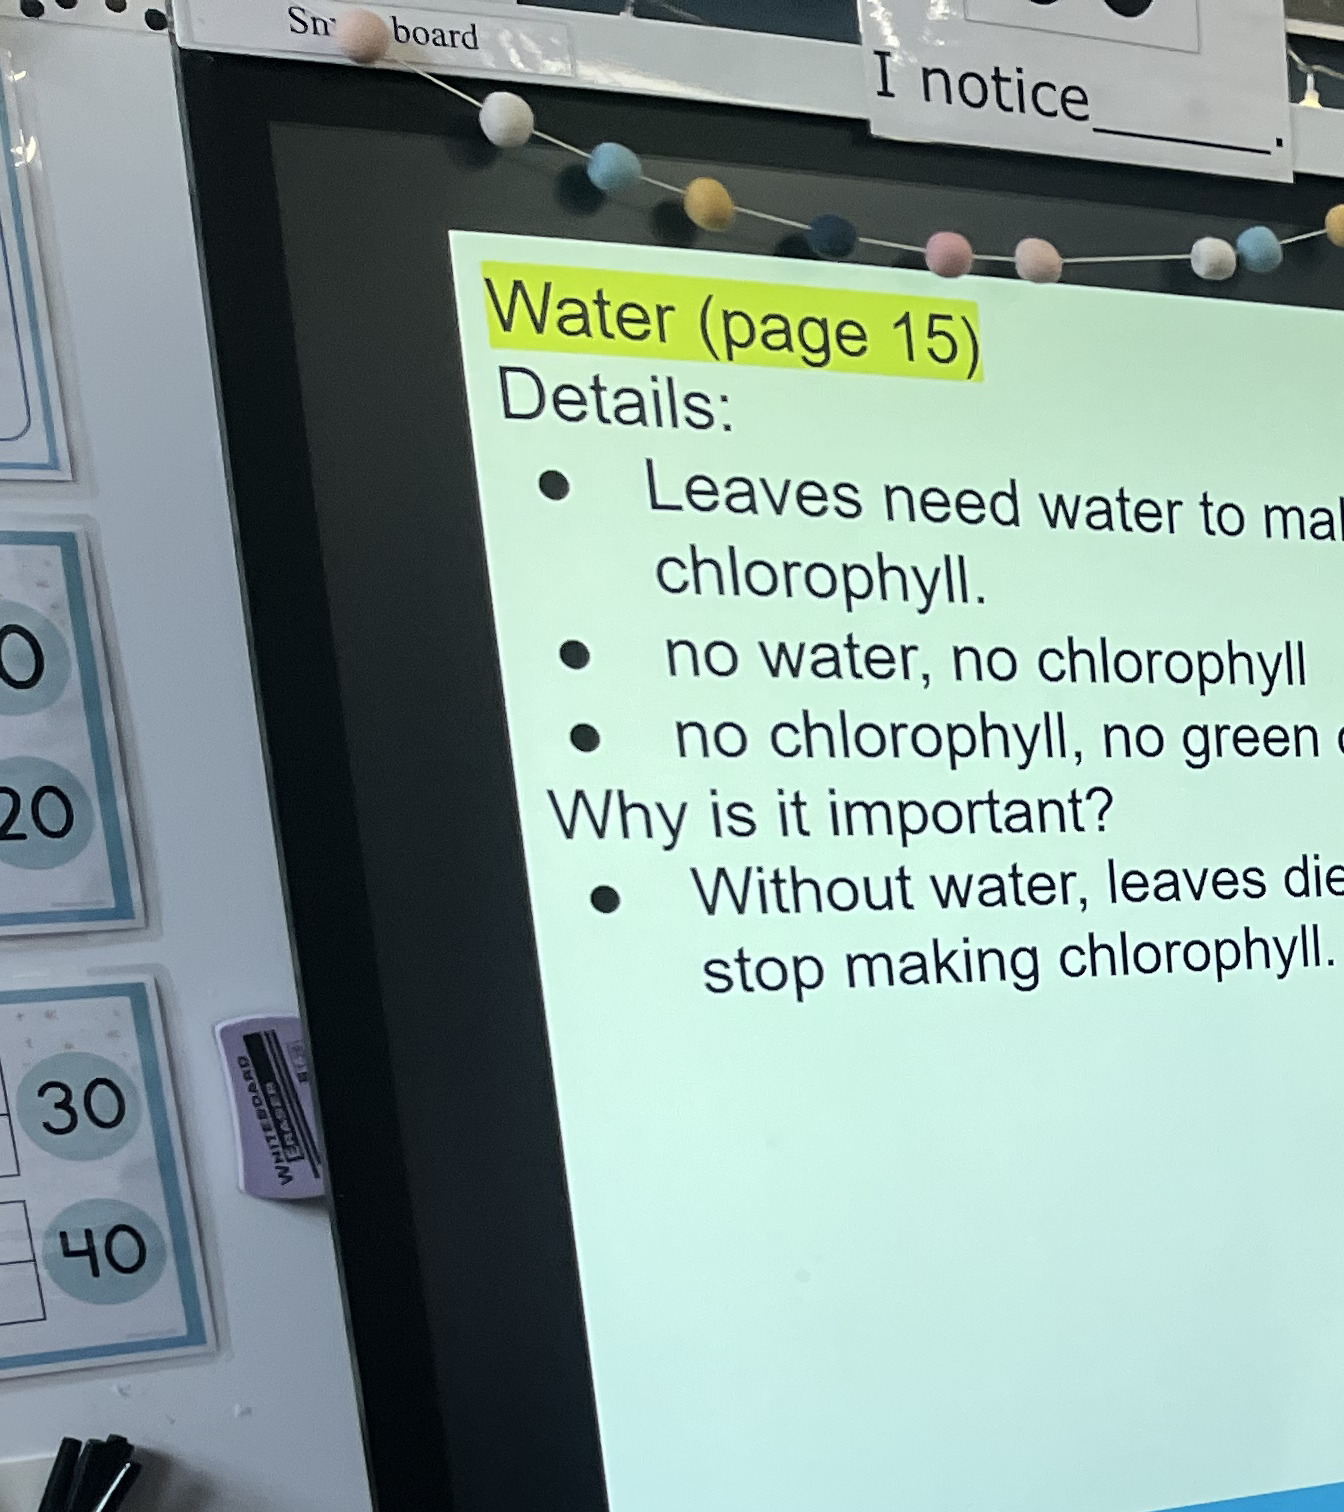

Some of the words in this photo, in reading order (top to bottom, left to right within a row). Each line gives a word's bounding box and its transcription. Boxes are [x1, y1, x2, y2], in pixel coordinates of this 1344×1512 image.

[872, 51, 893, 98] I
[484, 277, 676, 343] Water
[700, 294, 868, 368] (page
[893, 311, 979, 380] 15)
[498, 365, 732, 432] Details:
[645, 458, 863, 519] Leaves
[884, 478, 1020, 527] need
[1038, 486, 1184, 534] water
[1199, 491, 1245, 537] to
[656, 543, 985, 615] chlorophyll.
[666, 639, 738, 677] no
[758, 632, 930, 689] water,
[953, 645, 1017, 682] no
[1038, 635, 1306, 697] chlorophyll
[676, 721, 748, 758] no
[771, 709, 1082, 771] chlorophyll,
[1103, 723, 1164, 758] no
[1182, 724, 1319, 770] green
[689, 865, 915, 916] Without
[929, 862, 1087, 912] water,
[1108, 858, 1267, 904] leaves
[704, 947, 824, 1003] stop
[846, 936, 1039, 992] making
[1059, 923, 1334, 983] chlorophyll.
[37, 1077, 127, 1135] 30
[237, 1056, 293, 1185] WHITEBOARD
[266, 1081, 300, 1161] ERASER
[58, 1223, 147, 1278] 40
